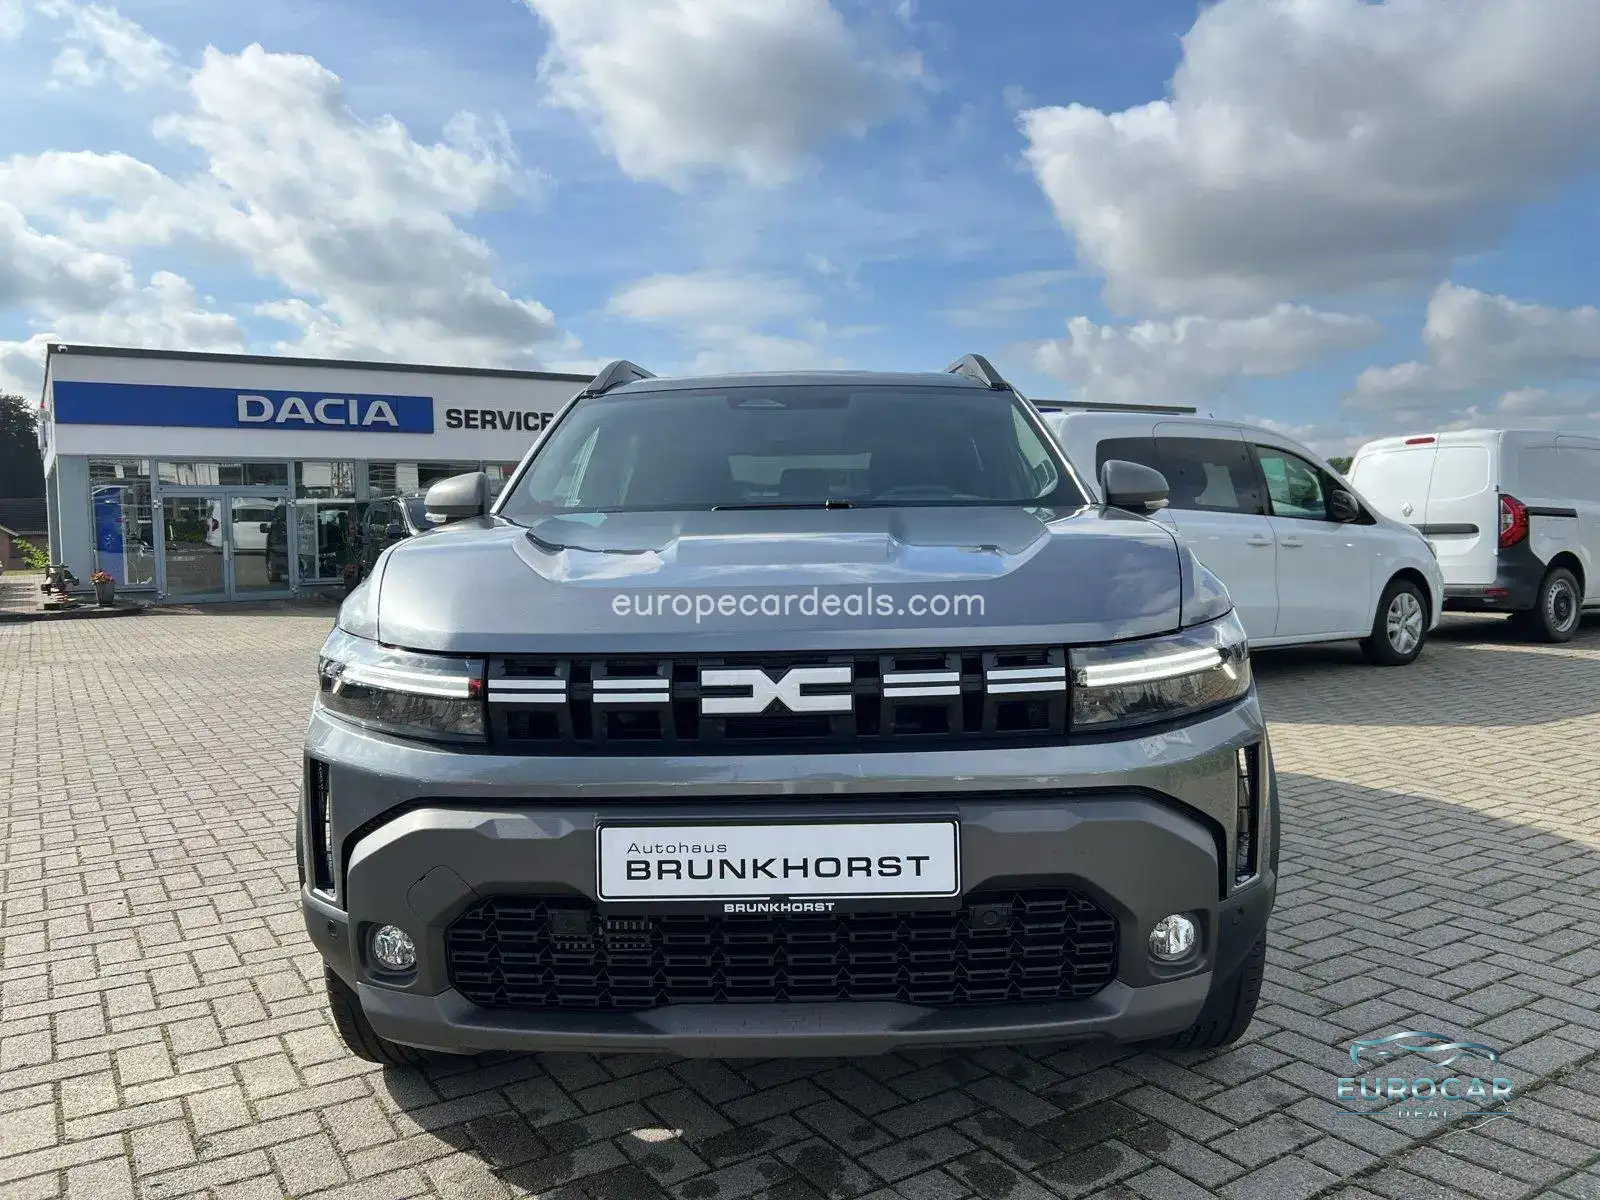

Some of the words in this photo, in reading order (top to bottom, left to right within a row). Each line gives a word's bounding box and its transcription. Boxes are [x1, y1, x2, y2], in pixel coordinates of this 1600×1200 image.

[237, 395, 398, 428] DACIA
[626, 842, 728, 854] Autohaus
[626, 856, 930, 880] BRUNKHORST
[724, 903, 835, 913] BRUNKHORST
